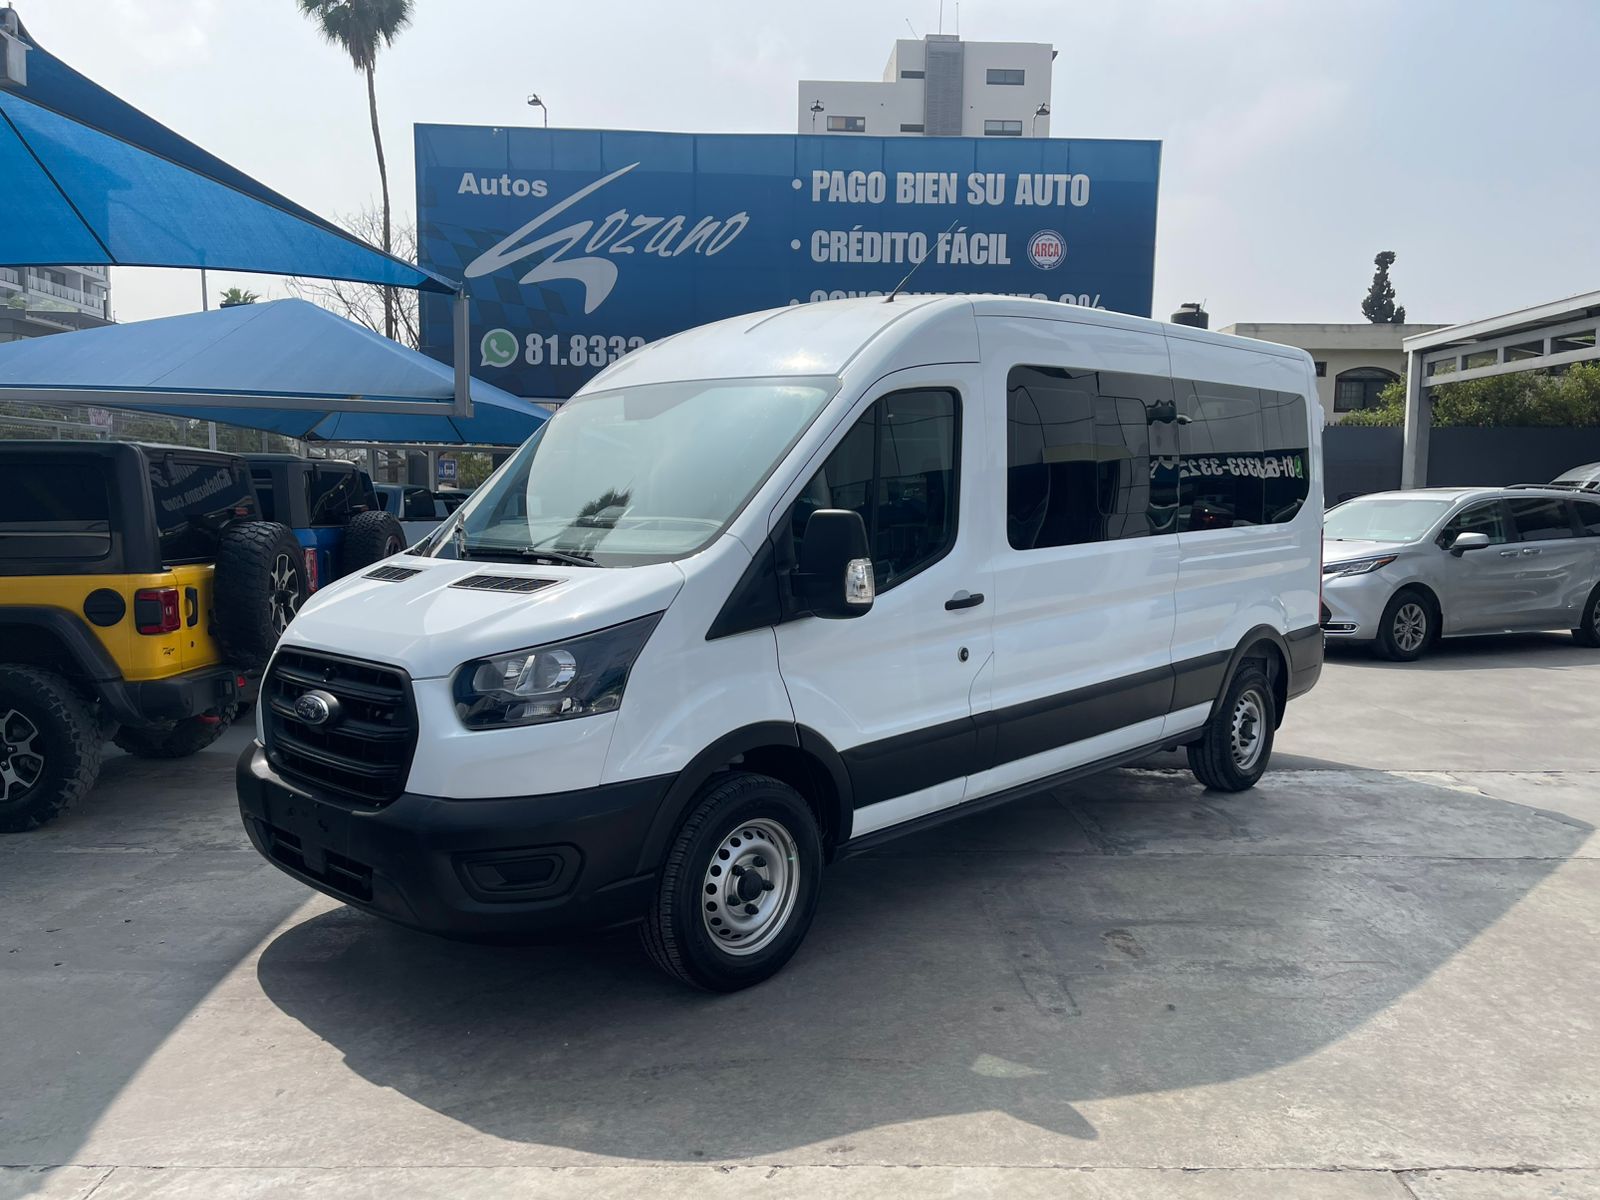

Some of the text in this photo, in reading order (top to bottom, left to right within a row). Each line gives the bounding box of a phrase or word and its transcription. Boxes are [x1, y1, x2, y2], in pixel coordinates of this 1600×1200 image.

[457, 172, 549, 198] Autos
[812, 170, 1091, 207] PAGO BIEN SU AUTO
[810, 224, 1012, 265] CRÉDITO FÁCIL
[1033, 240, 1060, 259] ARCA
